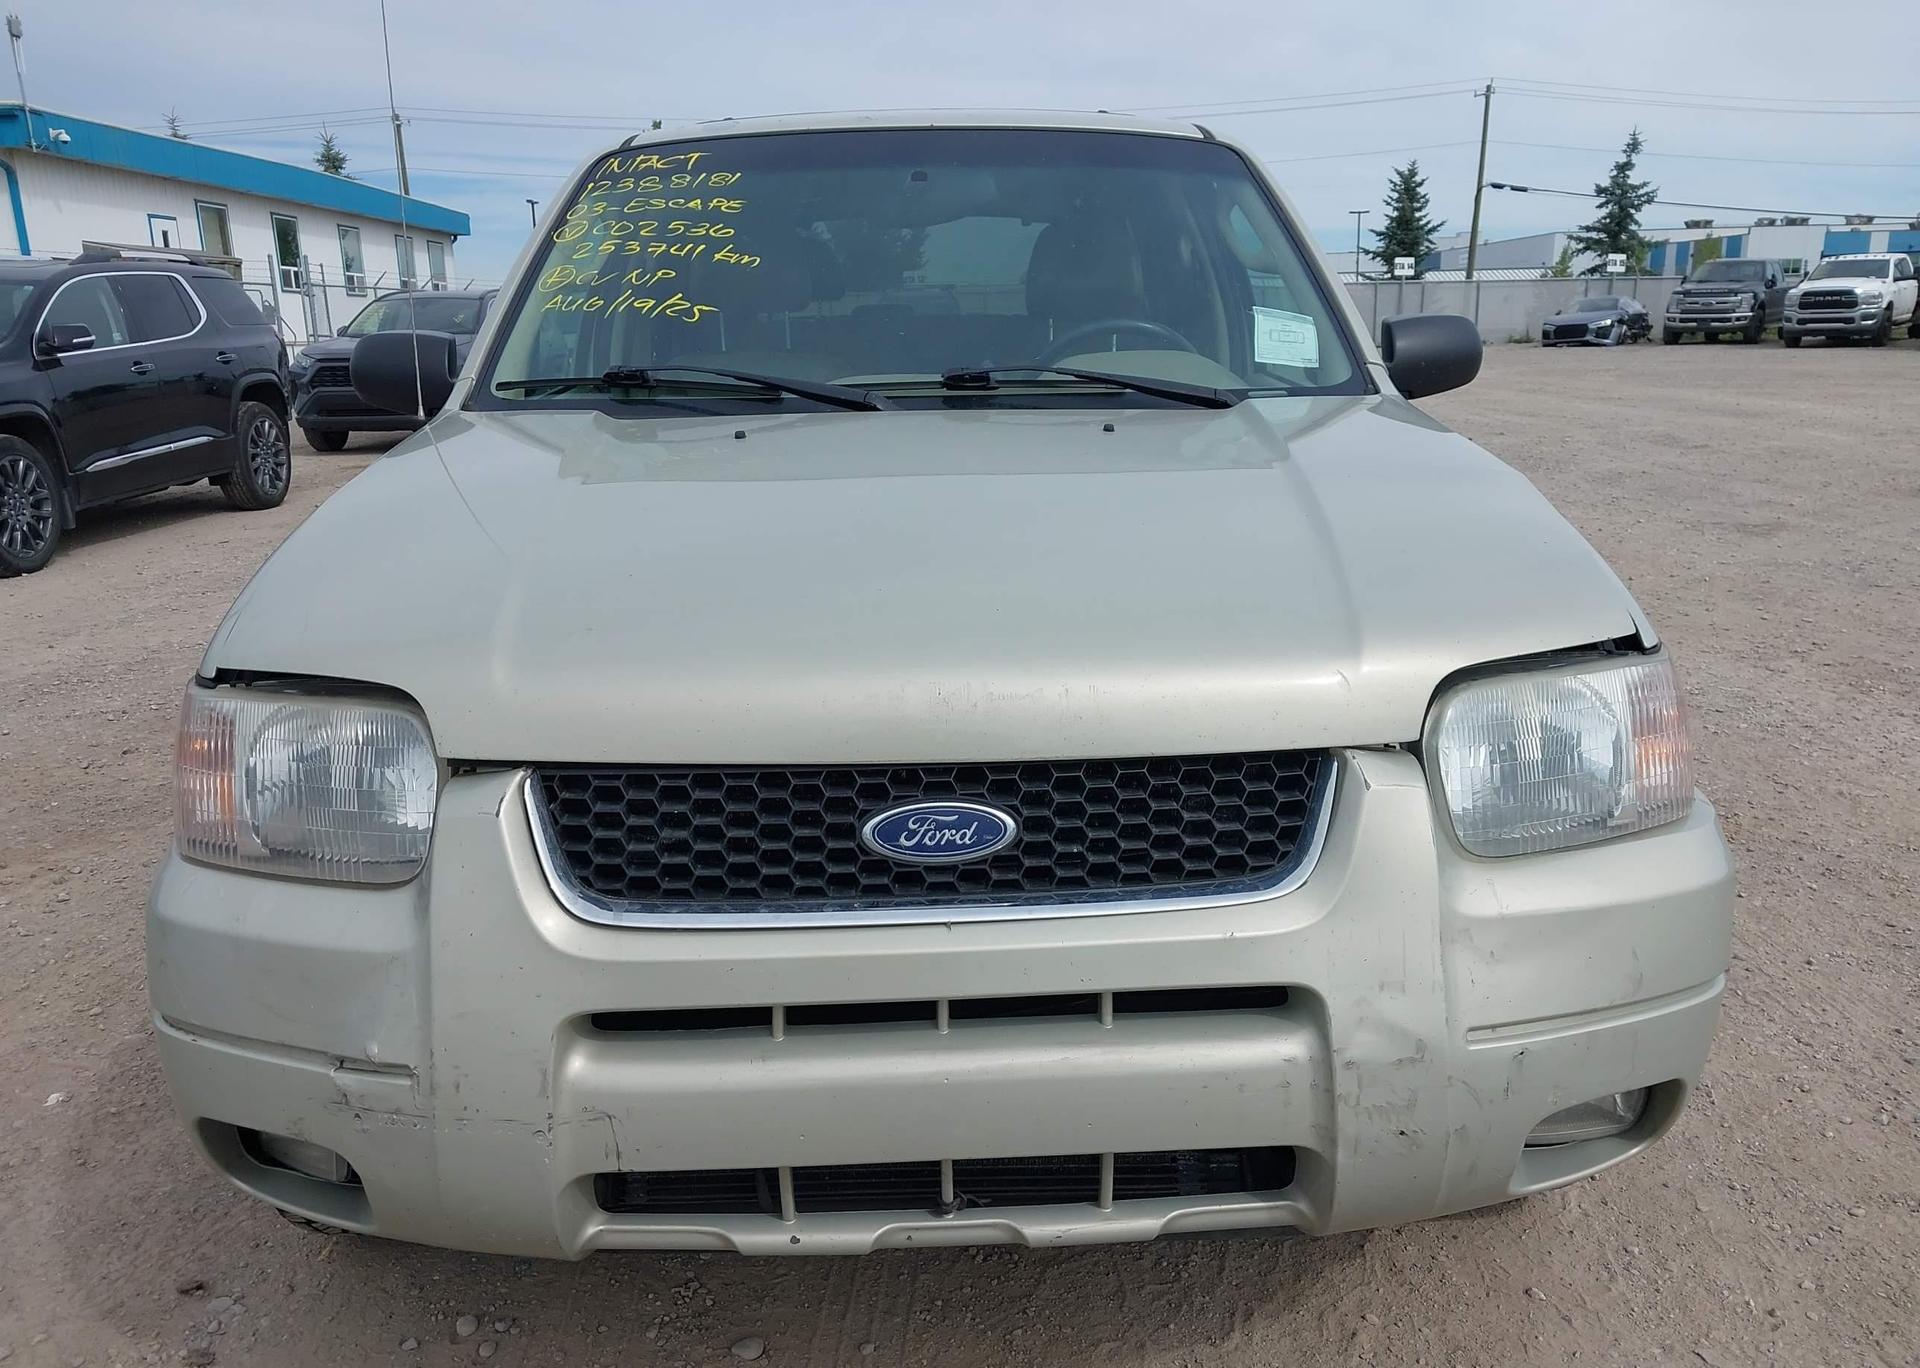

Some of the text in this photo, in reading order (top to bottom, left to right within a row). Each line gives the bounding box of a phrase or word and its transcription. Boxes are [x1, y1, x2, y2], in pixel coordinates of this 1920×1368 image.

[596, 152, 712, 179] INTACT
[572, 240, 706, 261] 253741
[540, 289, 721, 322] AUG/19/25
[900, 814, 979, 847] Ford
